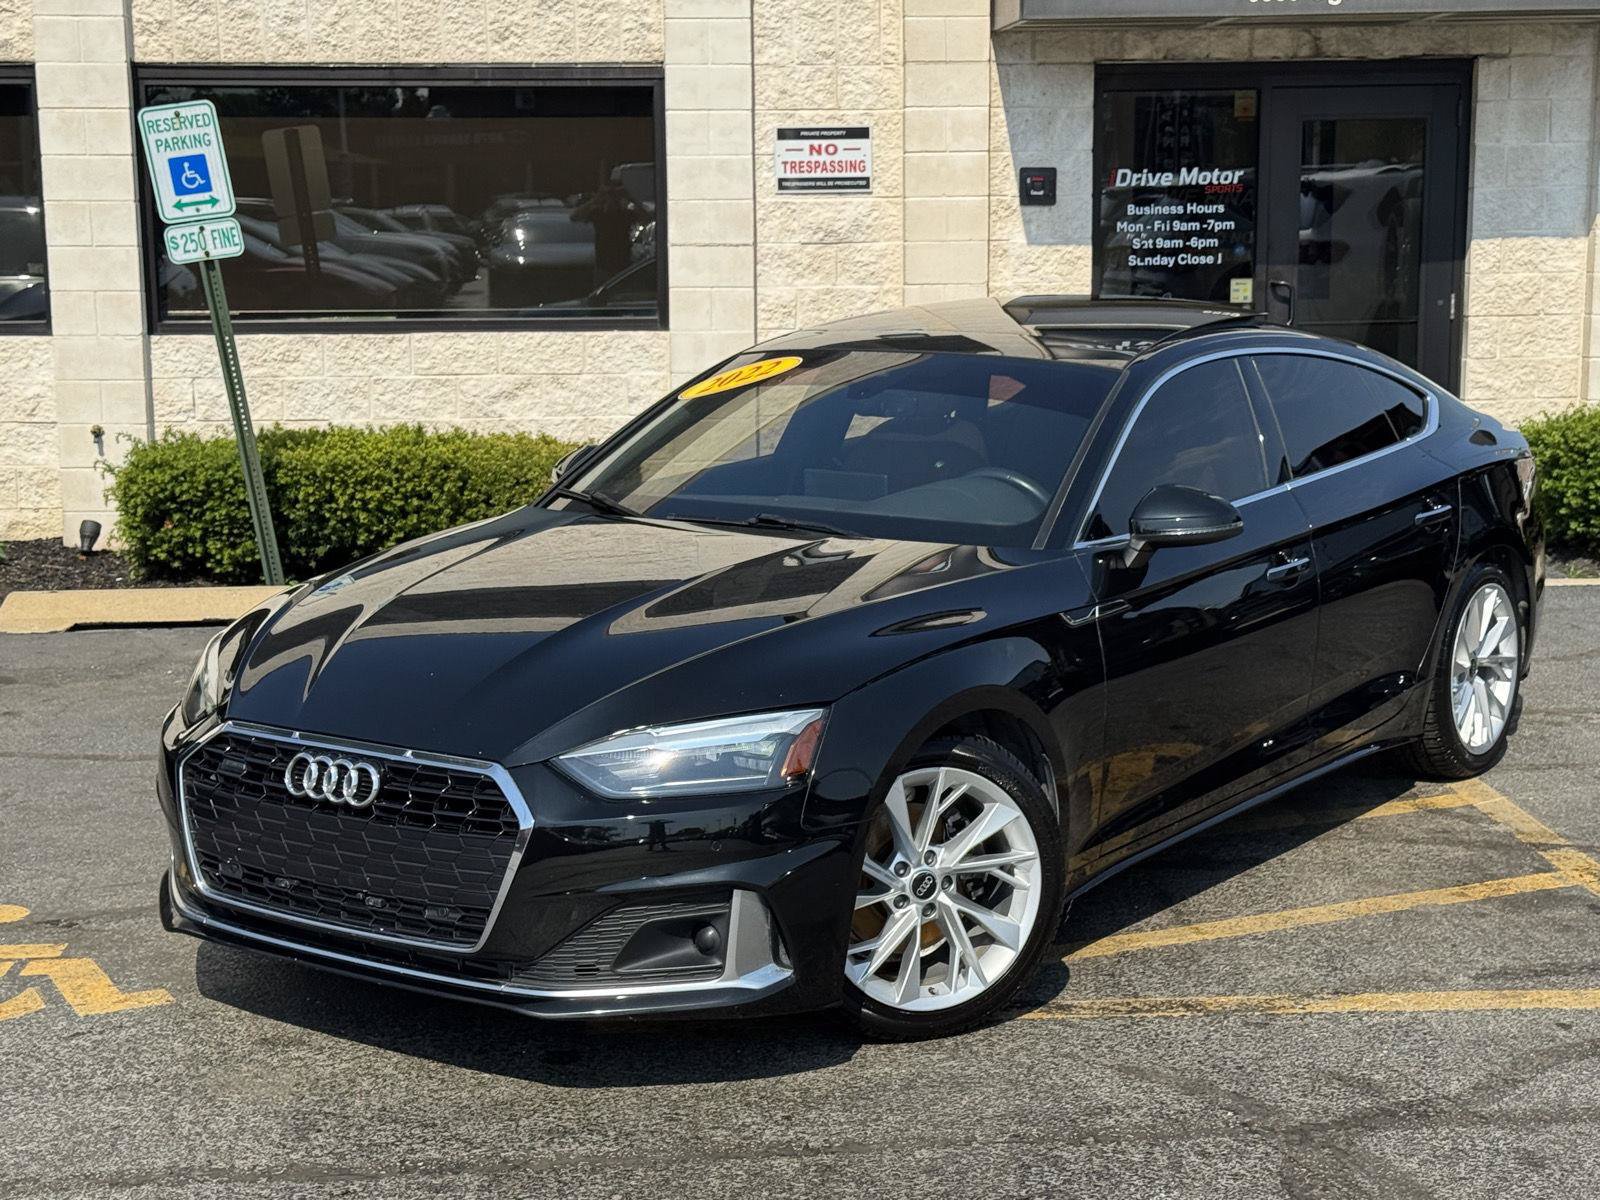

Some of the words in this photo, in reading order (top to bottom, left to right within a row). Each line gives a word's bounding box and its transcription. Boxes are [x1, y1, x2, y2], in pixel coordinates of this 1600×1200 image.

[147, 113, 211, 134] RESERVED
[156, 132, 212, 154] PARKING
[809, 144, 838, 156] NO
[782, 160, 866, 174] TRESPASSING
[1178, 166, 1244, 186] Motor
[1204, 184, 1244, 194] SPORTS
[1127, 204, 1184, 215] Business
[1187, 202, 1225, 213] Hours
[1116, 220, 1144, 232] Mon
[1172, 220, 1200, 231] 9am
[169, 229, 207, 254] $250
[211, 226, 239, 250] FINE
[1155, 237, 1183, 248] 9am
[696, 360, 782, 395] 2022
